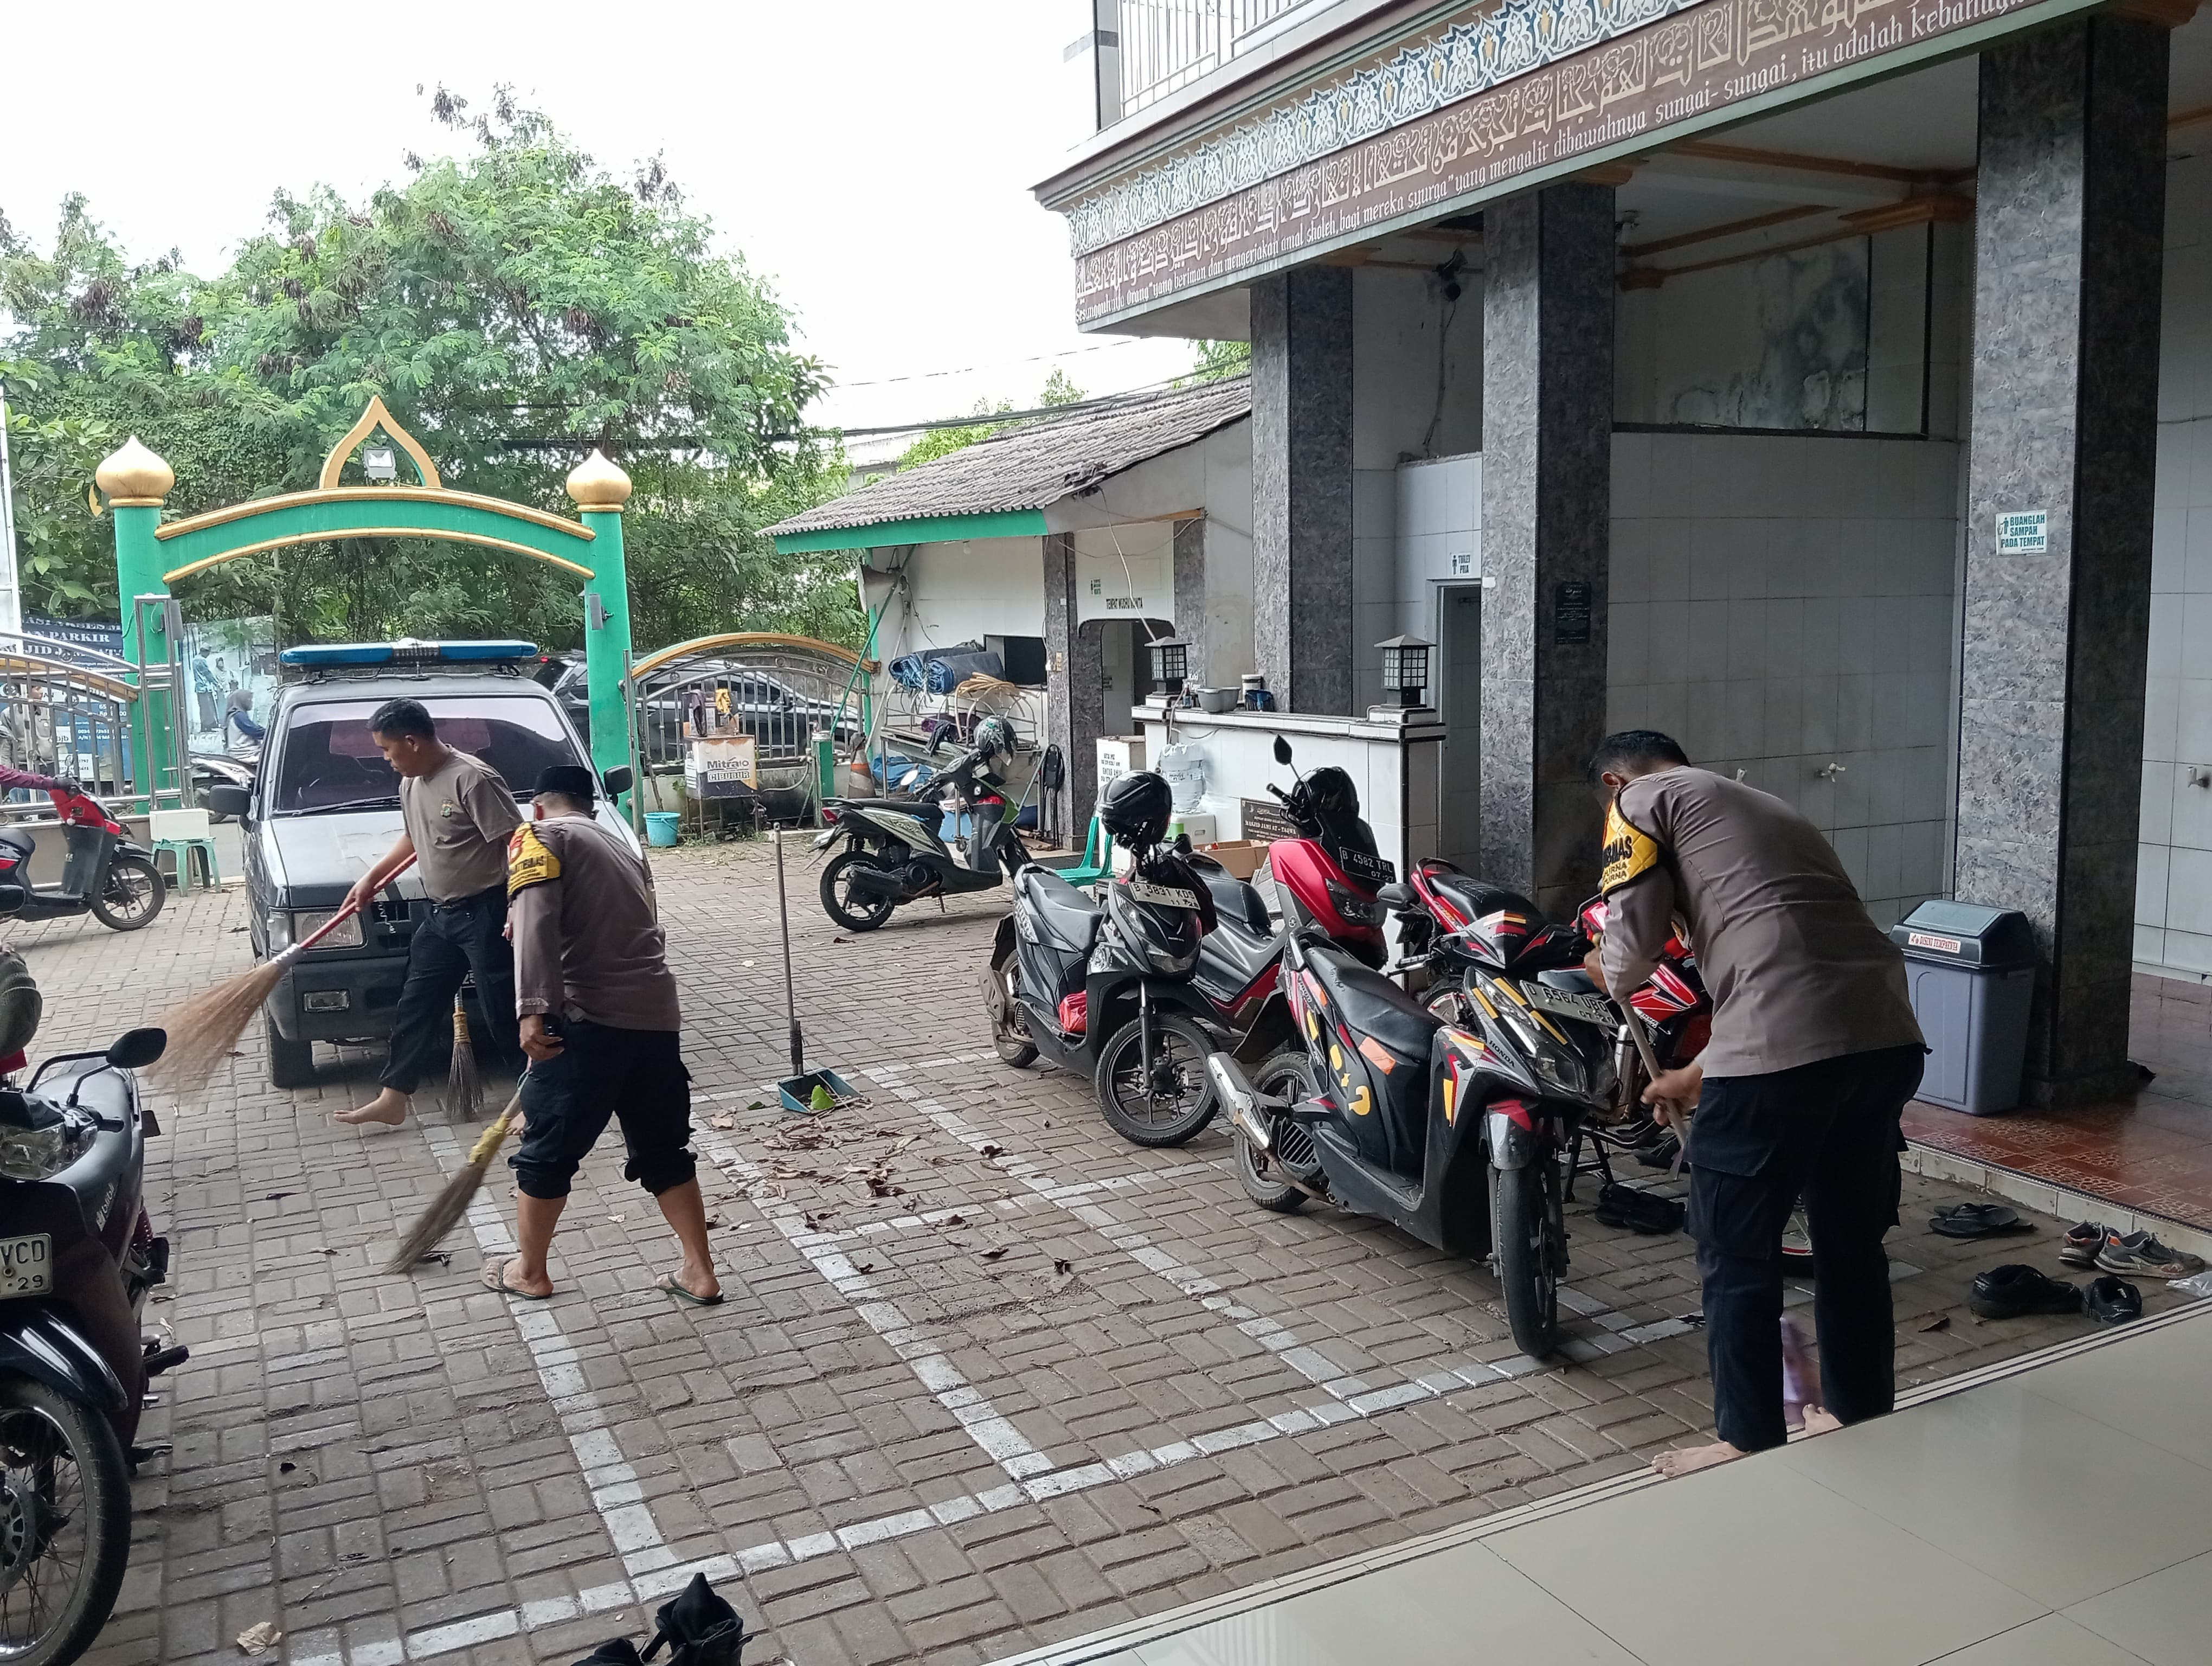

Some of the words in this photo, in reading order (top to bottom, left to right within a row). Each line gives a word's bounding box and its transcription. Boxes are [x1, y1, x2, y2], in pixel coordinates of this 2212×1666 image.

[1173, 266, 1206, 286] beriman
[1208, 257, 1224, 278] dan
[1224, 235, 1278, 272] mengerjakan
[1281, 222, 1304, 252] amal
[1340, 205, 1360, 233] bagi
[1362, 190, 1404, 223] mereka
[1454, 167, 1486, 196] yang
[1489, 139, 1549, 180] mengalir
[1553, 110, 1647, 157] dibawahnya
[1801, 48, 1828, 74] itu
[1834, 15, 1903, 64] adalah
[2010, 514, 2045, 526] BUANGLAH
[2010, 526, 2037, 536] SAMPAH
[2001, 537, 2018, 548] PADA
[2019, 536, 2044, 547] TEMPAT
[1459, 565, 1469, 574] PRIA
[49, 631, 110, 643] PARKIR
[709, 771, 749, 781] CIBUBUR
[1341, 849, 1349, 860] B
[1353, 854, 1374, 868] 4582
[1376, 860, 1393, 874] TRL
[1133, 883, 1141, 892] B
[1145, 885, 1171, 897] 5831
[1175, 889, 1195, 900] KDS
[1526, 983, 1536, 995] D
[1542, 988, 1579, 1005] 6564
[1489, 1040, 1515, 1068] HONDA
[0, 1239, 46, 1266] VCD
